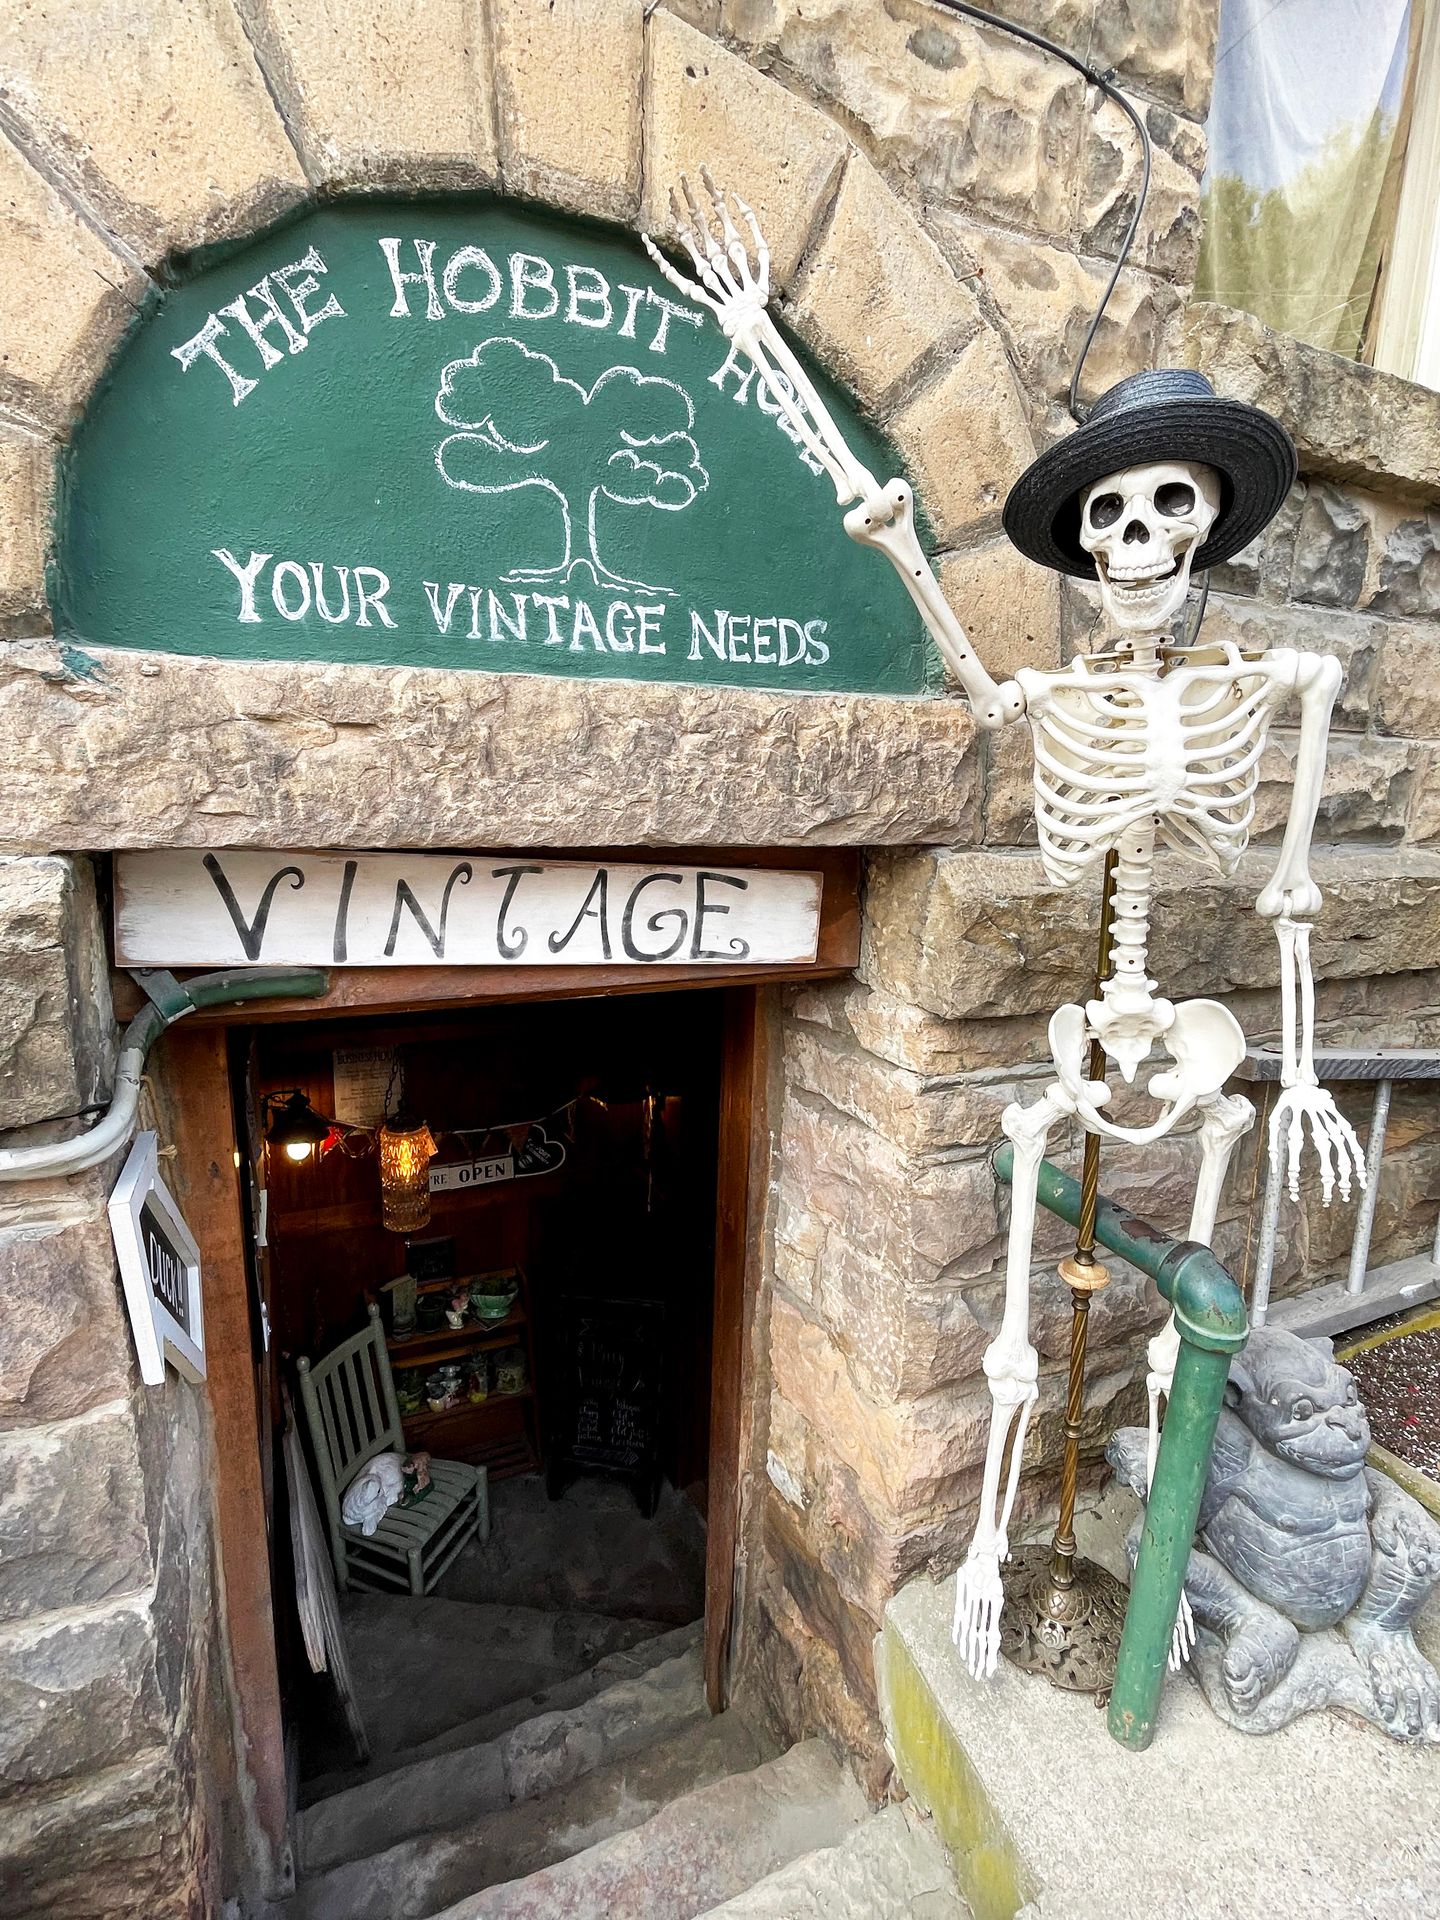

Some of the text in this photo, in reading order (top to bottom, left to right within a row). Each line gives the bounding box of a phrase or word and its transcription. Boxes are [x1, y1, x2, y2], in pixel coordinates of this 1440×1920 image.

[170, 237, 828, 477] THE HOBBIT HO
[210, 548, 830, 666] YOUR VINTAGE NEEDS
[202, 852, 751, 962] VINTAGE
[458, 1162, 506, 1183] OPEN
